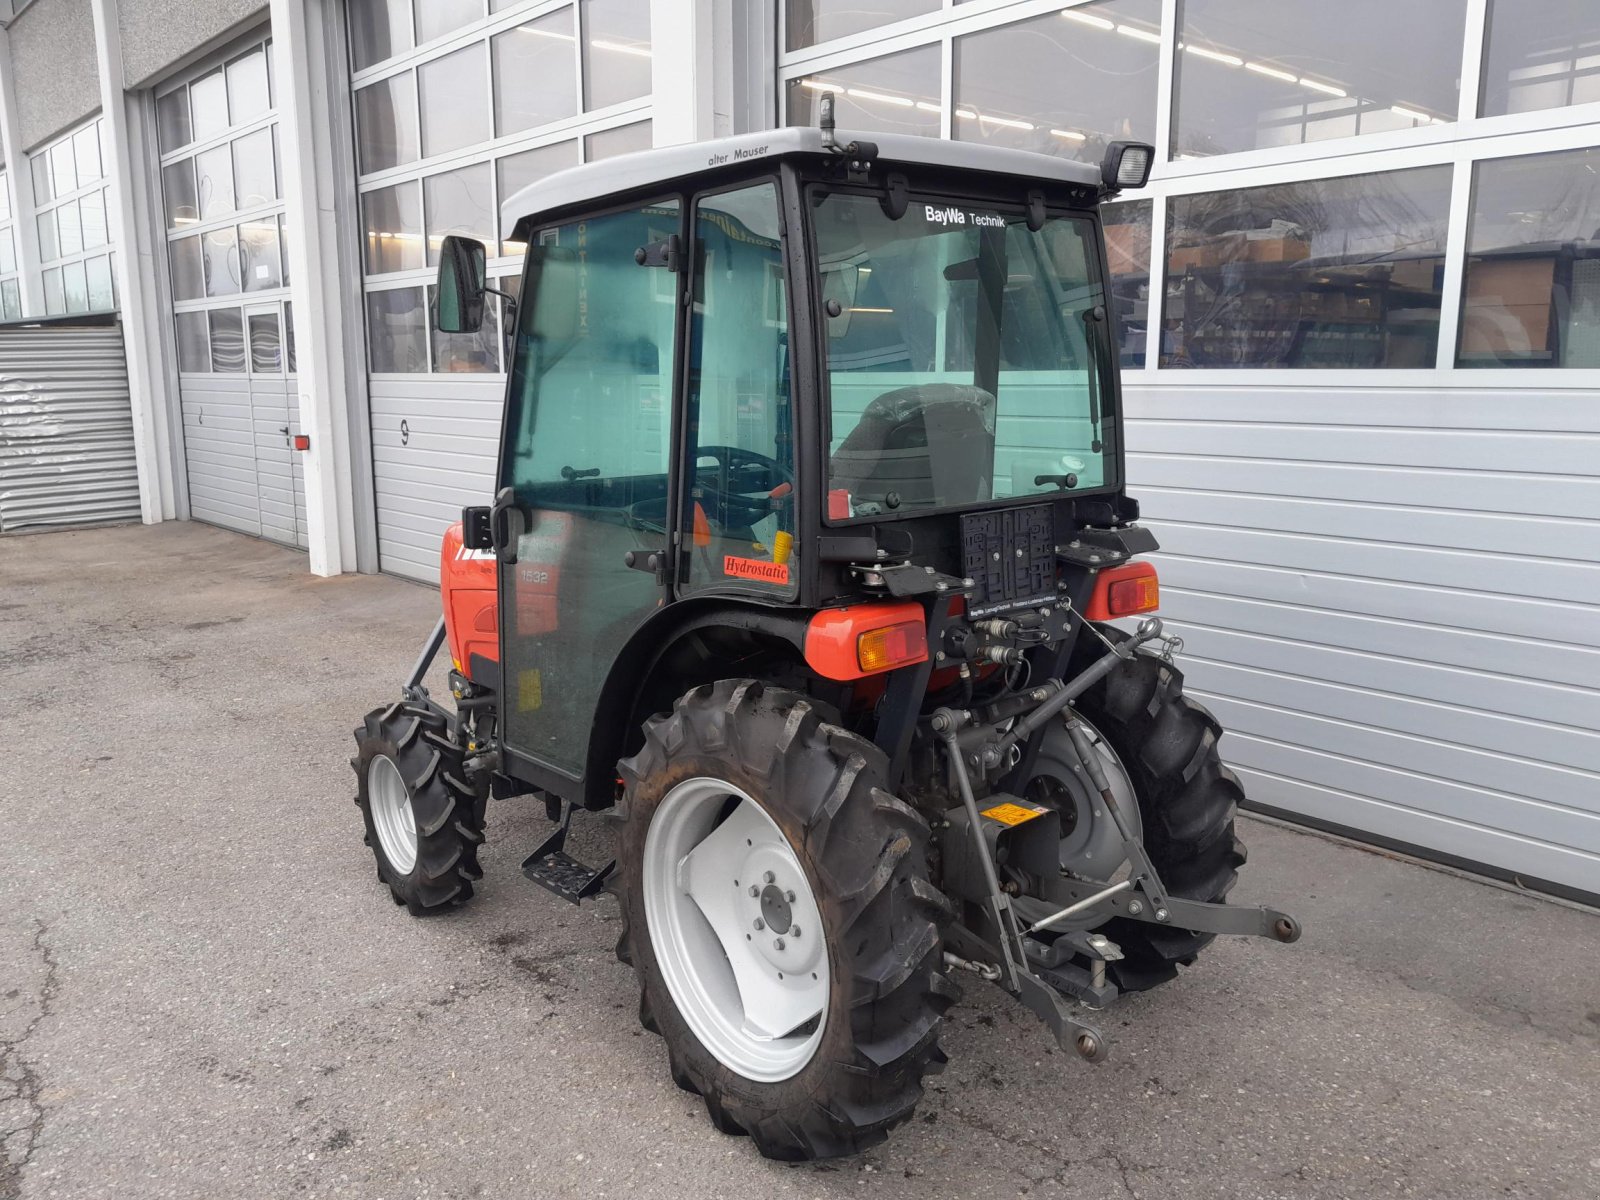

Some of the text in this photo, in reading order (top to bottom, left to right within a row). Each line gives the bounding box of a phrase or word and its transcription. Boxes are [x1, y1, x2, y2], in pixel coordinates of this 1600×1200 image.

[708, 145, 768, 166] alter Mauser
[925, 205, 1006, 228] BayWa Technik
[726, 557, 787, 580] Hydrostatic
